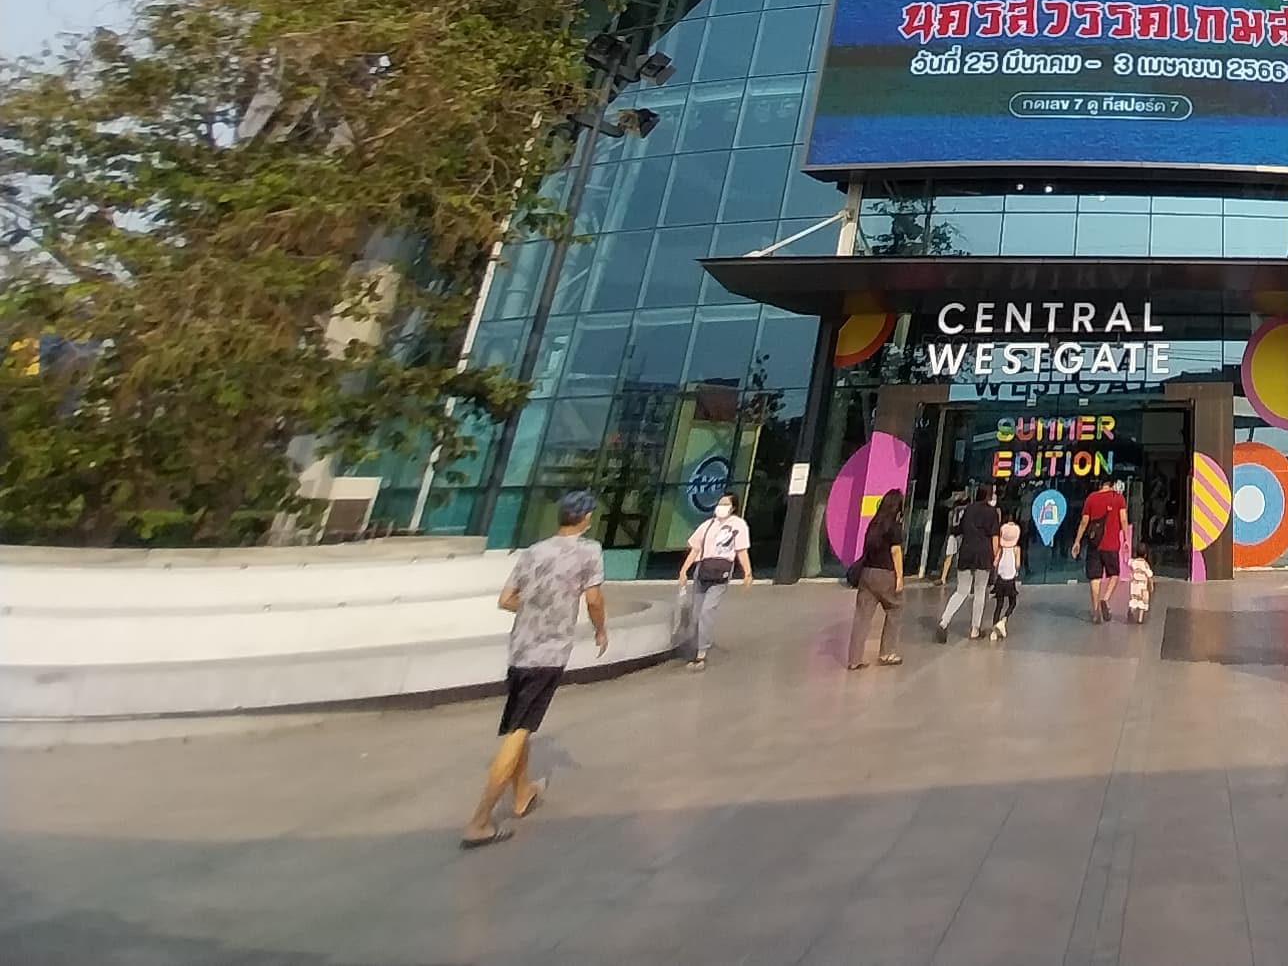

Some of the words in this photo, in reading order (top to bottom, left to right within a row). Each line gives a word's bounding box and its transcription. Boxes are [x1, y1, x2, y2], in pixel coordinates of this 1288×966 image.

[910, 45, 962, 75] วันที่
[963, 52, 998, 75] 25
[1002, 51, 1081, 75] มีนาคม
[1113, 54, 1133, 75] 3
[1137, 57, 1221, 79] เมษายน
[1169, 101, 1180, 113] 7
[937, 302, 1165, 335] CENTRAL
[928, 342, 1171, 376] WESTGATE
[996, 416, 1116, 442] SUMMER
[992, 451, 1115, 477] EDITION
